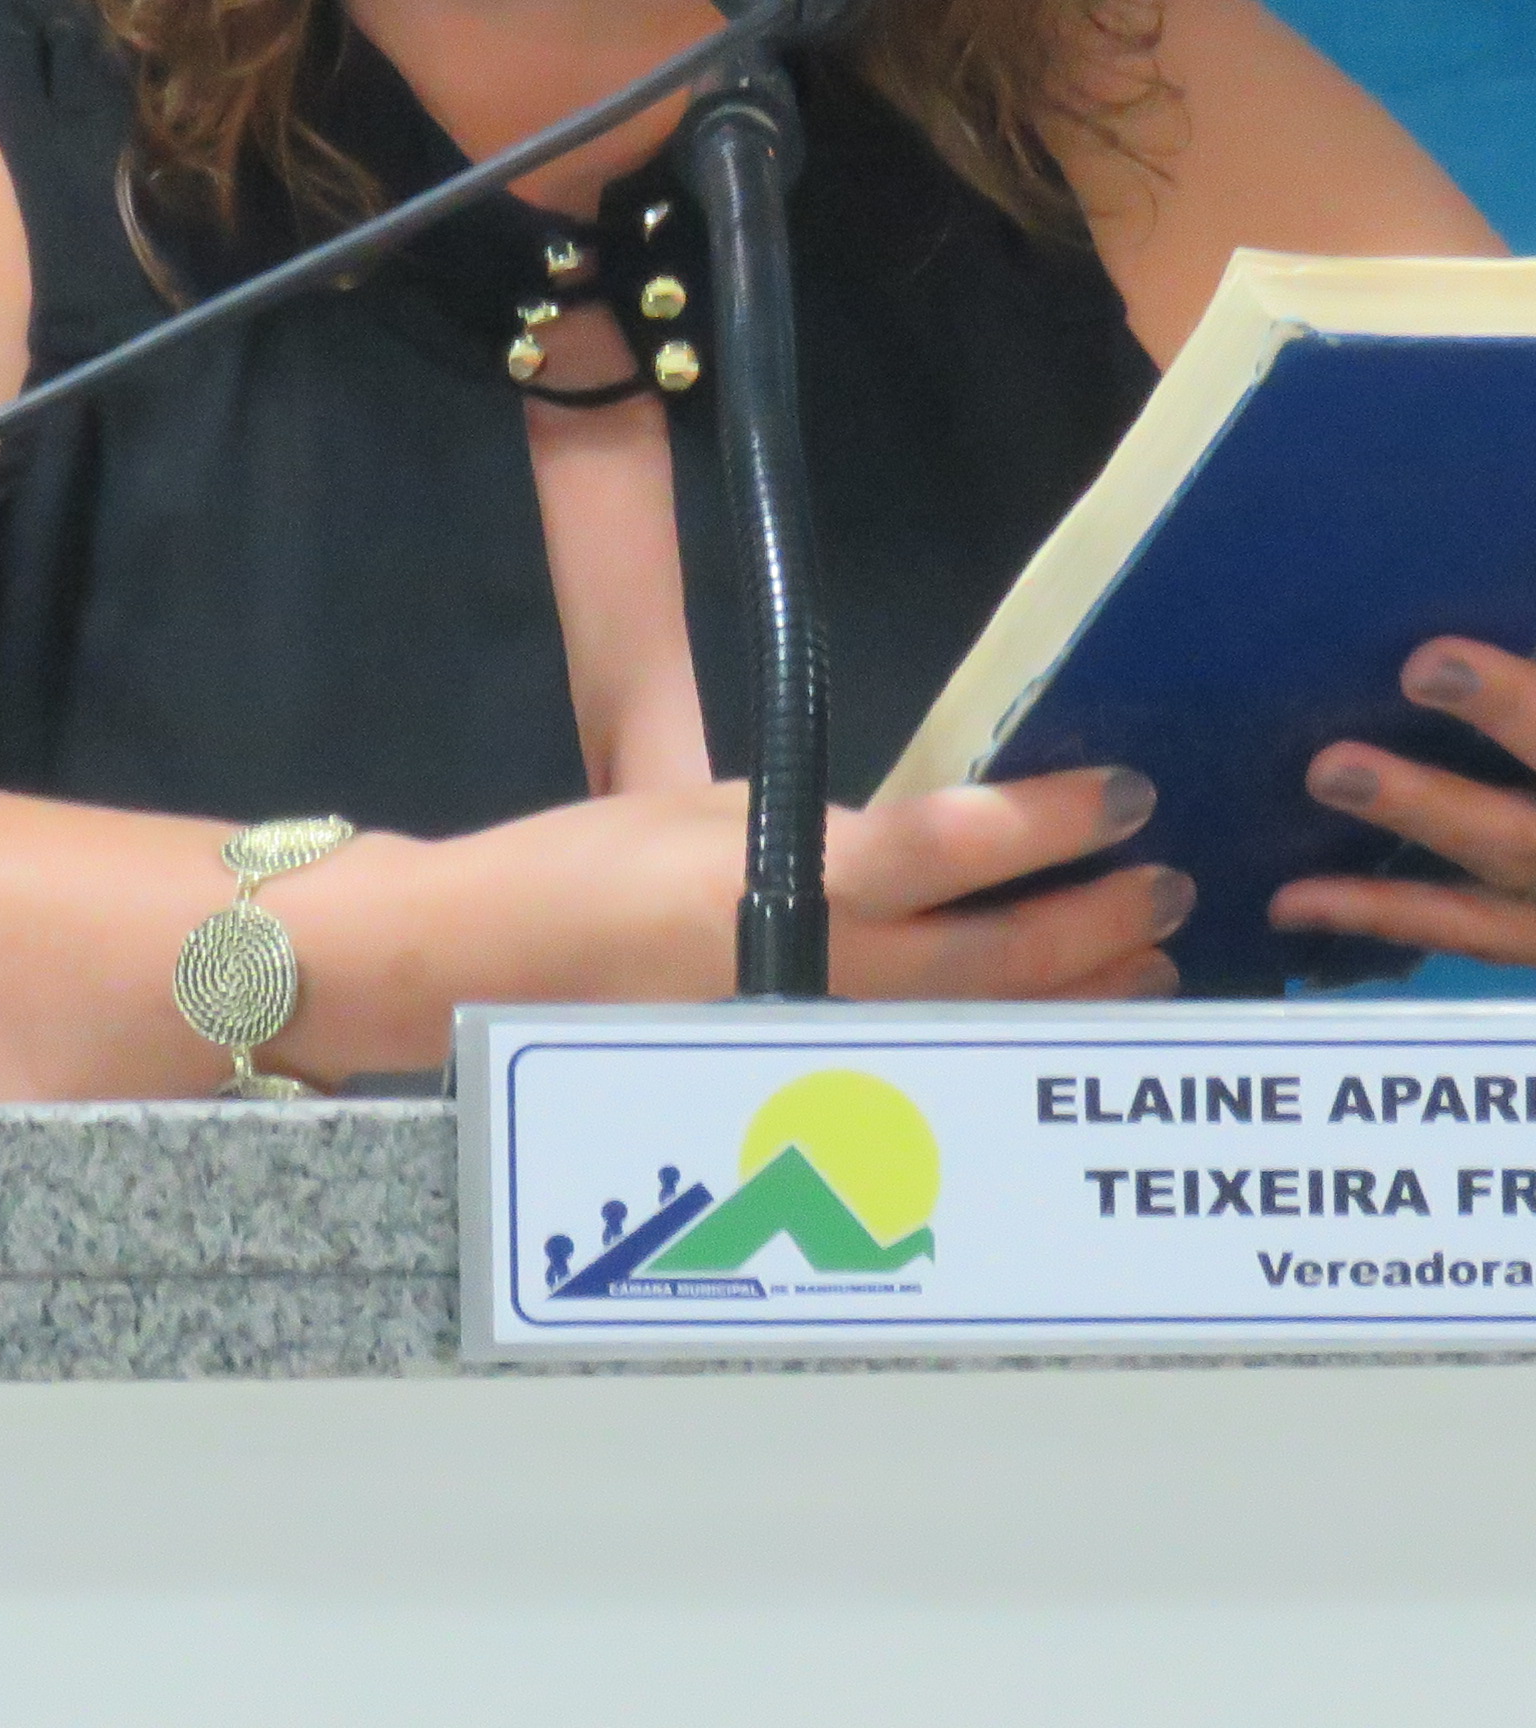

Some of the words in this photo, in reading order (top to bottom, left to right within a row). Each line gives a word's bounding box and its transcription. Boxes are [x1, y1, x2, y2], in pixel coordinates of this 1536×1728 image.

[1036, 1075, 1302, 1124] ELAINE
[1084, 1168, 1430, 1216] TEIXEIRA
[1256, 1251, 1533, 1286] Vereadora
